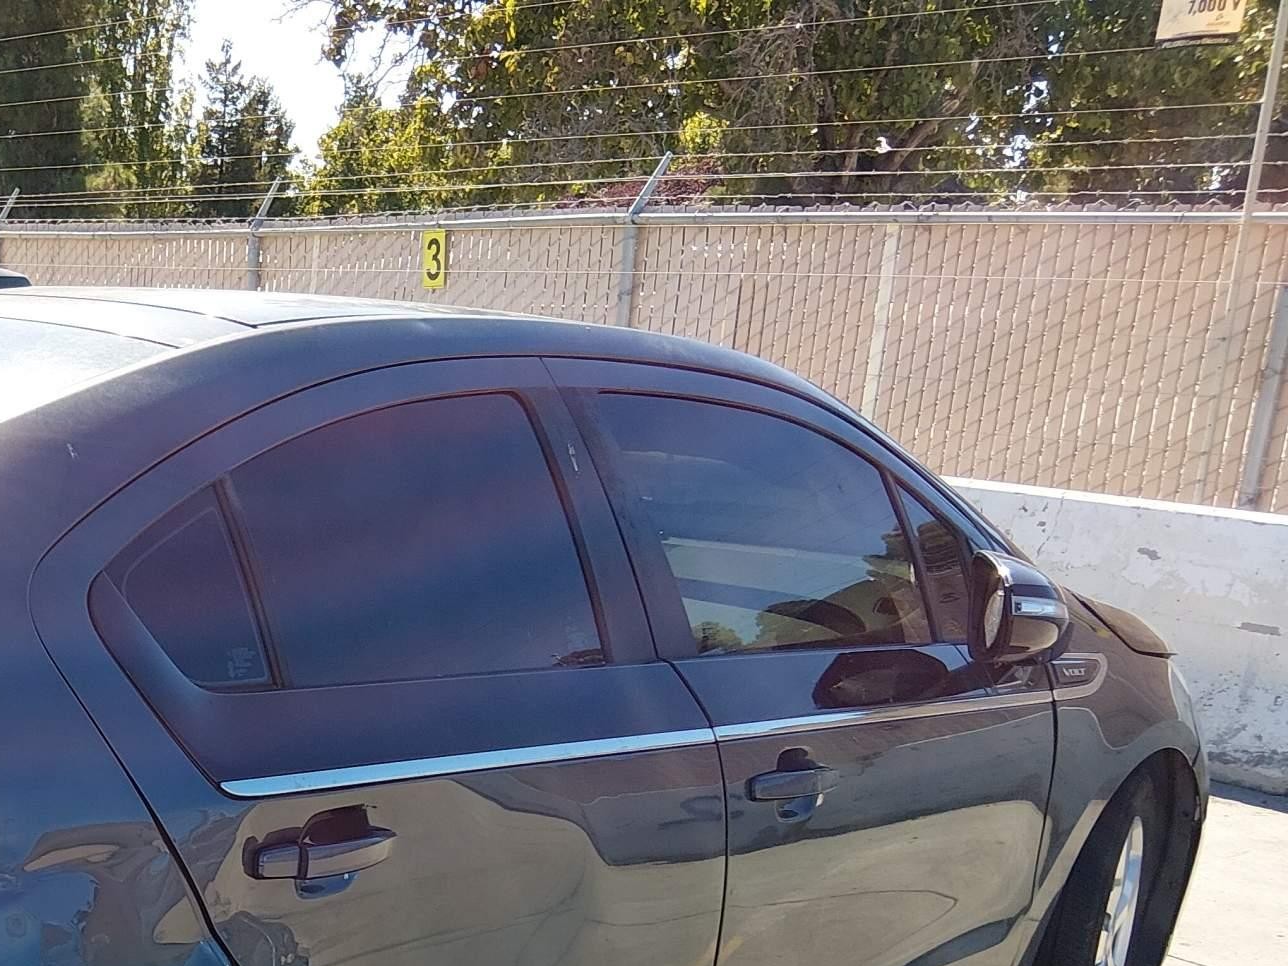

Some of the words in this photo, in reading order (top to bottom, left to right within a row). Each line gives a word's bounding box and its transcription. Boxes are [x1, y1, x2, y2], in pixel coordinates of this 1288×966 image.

[1187, 0, 1227, 16] 7,000
[427, 237, 442, 281] 3
[1063, 666, 1087, 677] VOLT
